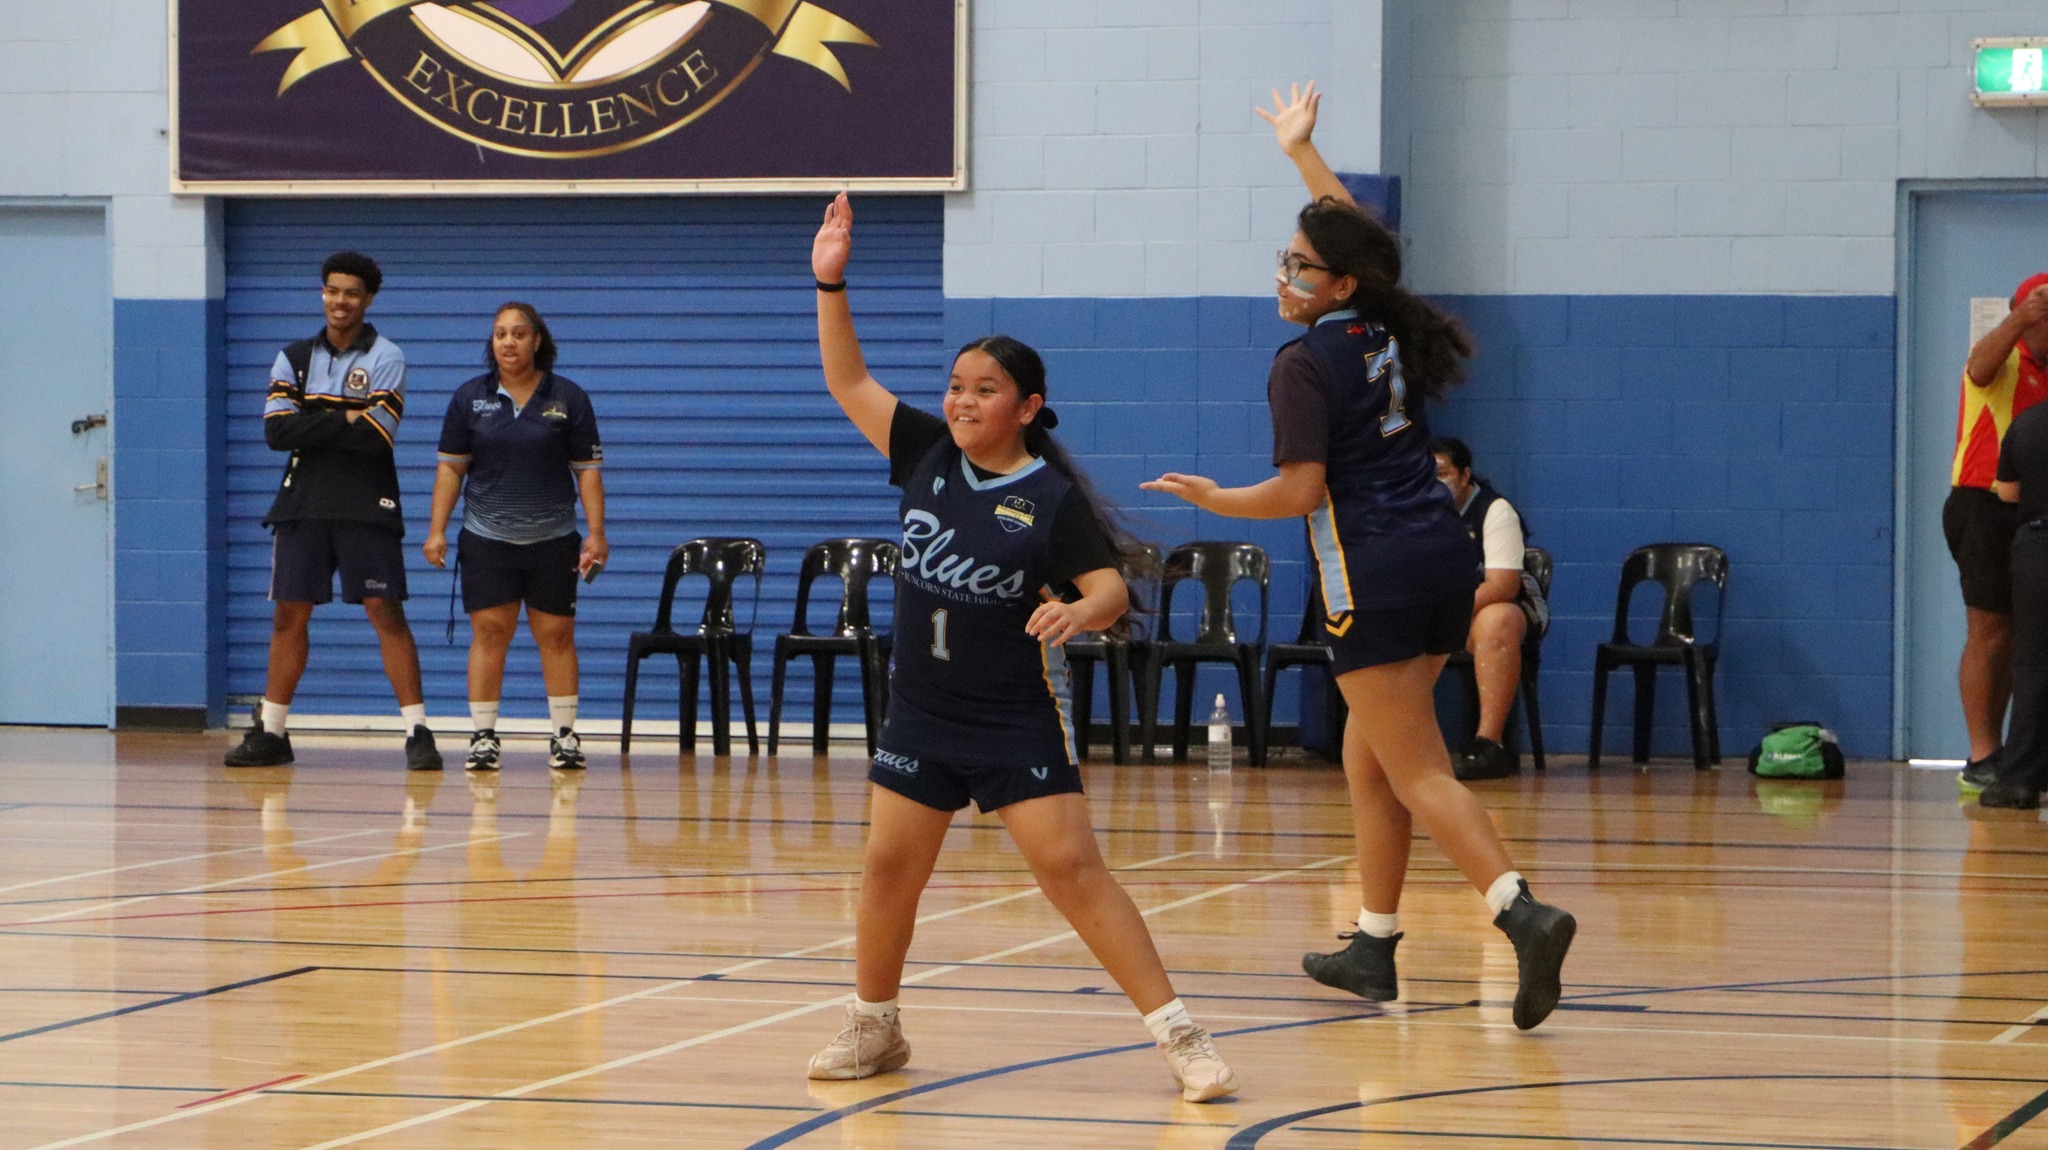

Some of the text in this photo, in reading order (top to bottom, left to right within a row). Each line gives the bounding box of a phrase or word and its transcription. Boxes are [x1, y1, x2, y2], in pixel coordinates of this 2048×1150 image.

[403, 49, 719, 138] EXCELLENCE
[1364, 336, 1412, 438] 7
[901, 508, 1025, 598] Blues
[941, 588, 972, 603] STATE
[931, 608, 950, 661] 1
